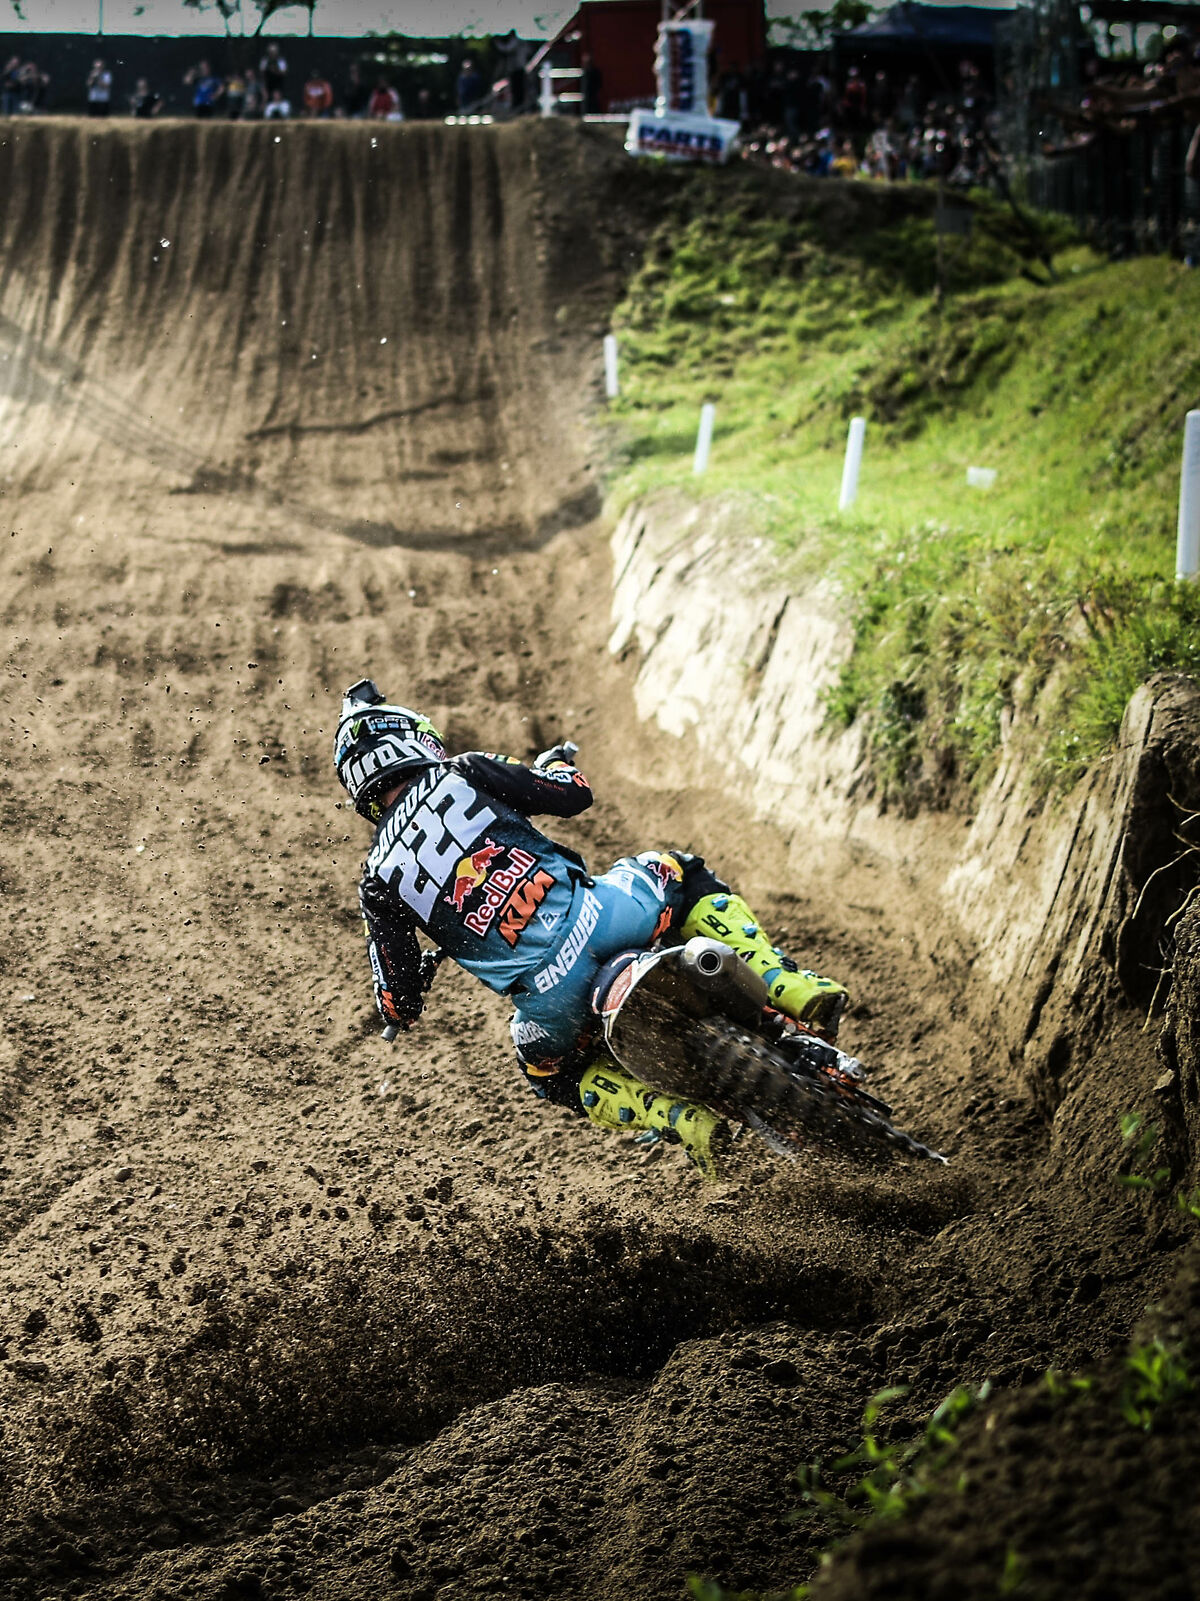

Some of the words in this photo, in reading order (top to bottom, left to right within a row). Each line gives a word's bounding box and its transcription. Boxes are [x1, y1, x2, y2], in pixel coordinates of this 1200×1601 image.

[639, 125, 723, 151] PARTS
[377, 772, 497, 924] 222
[499, 869, 555, 947] KTM
[534, 887, 604, 994] ANSWER
